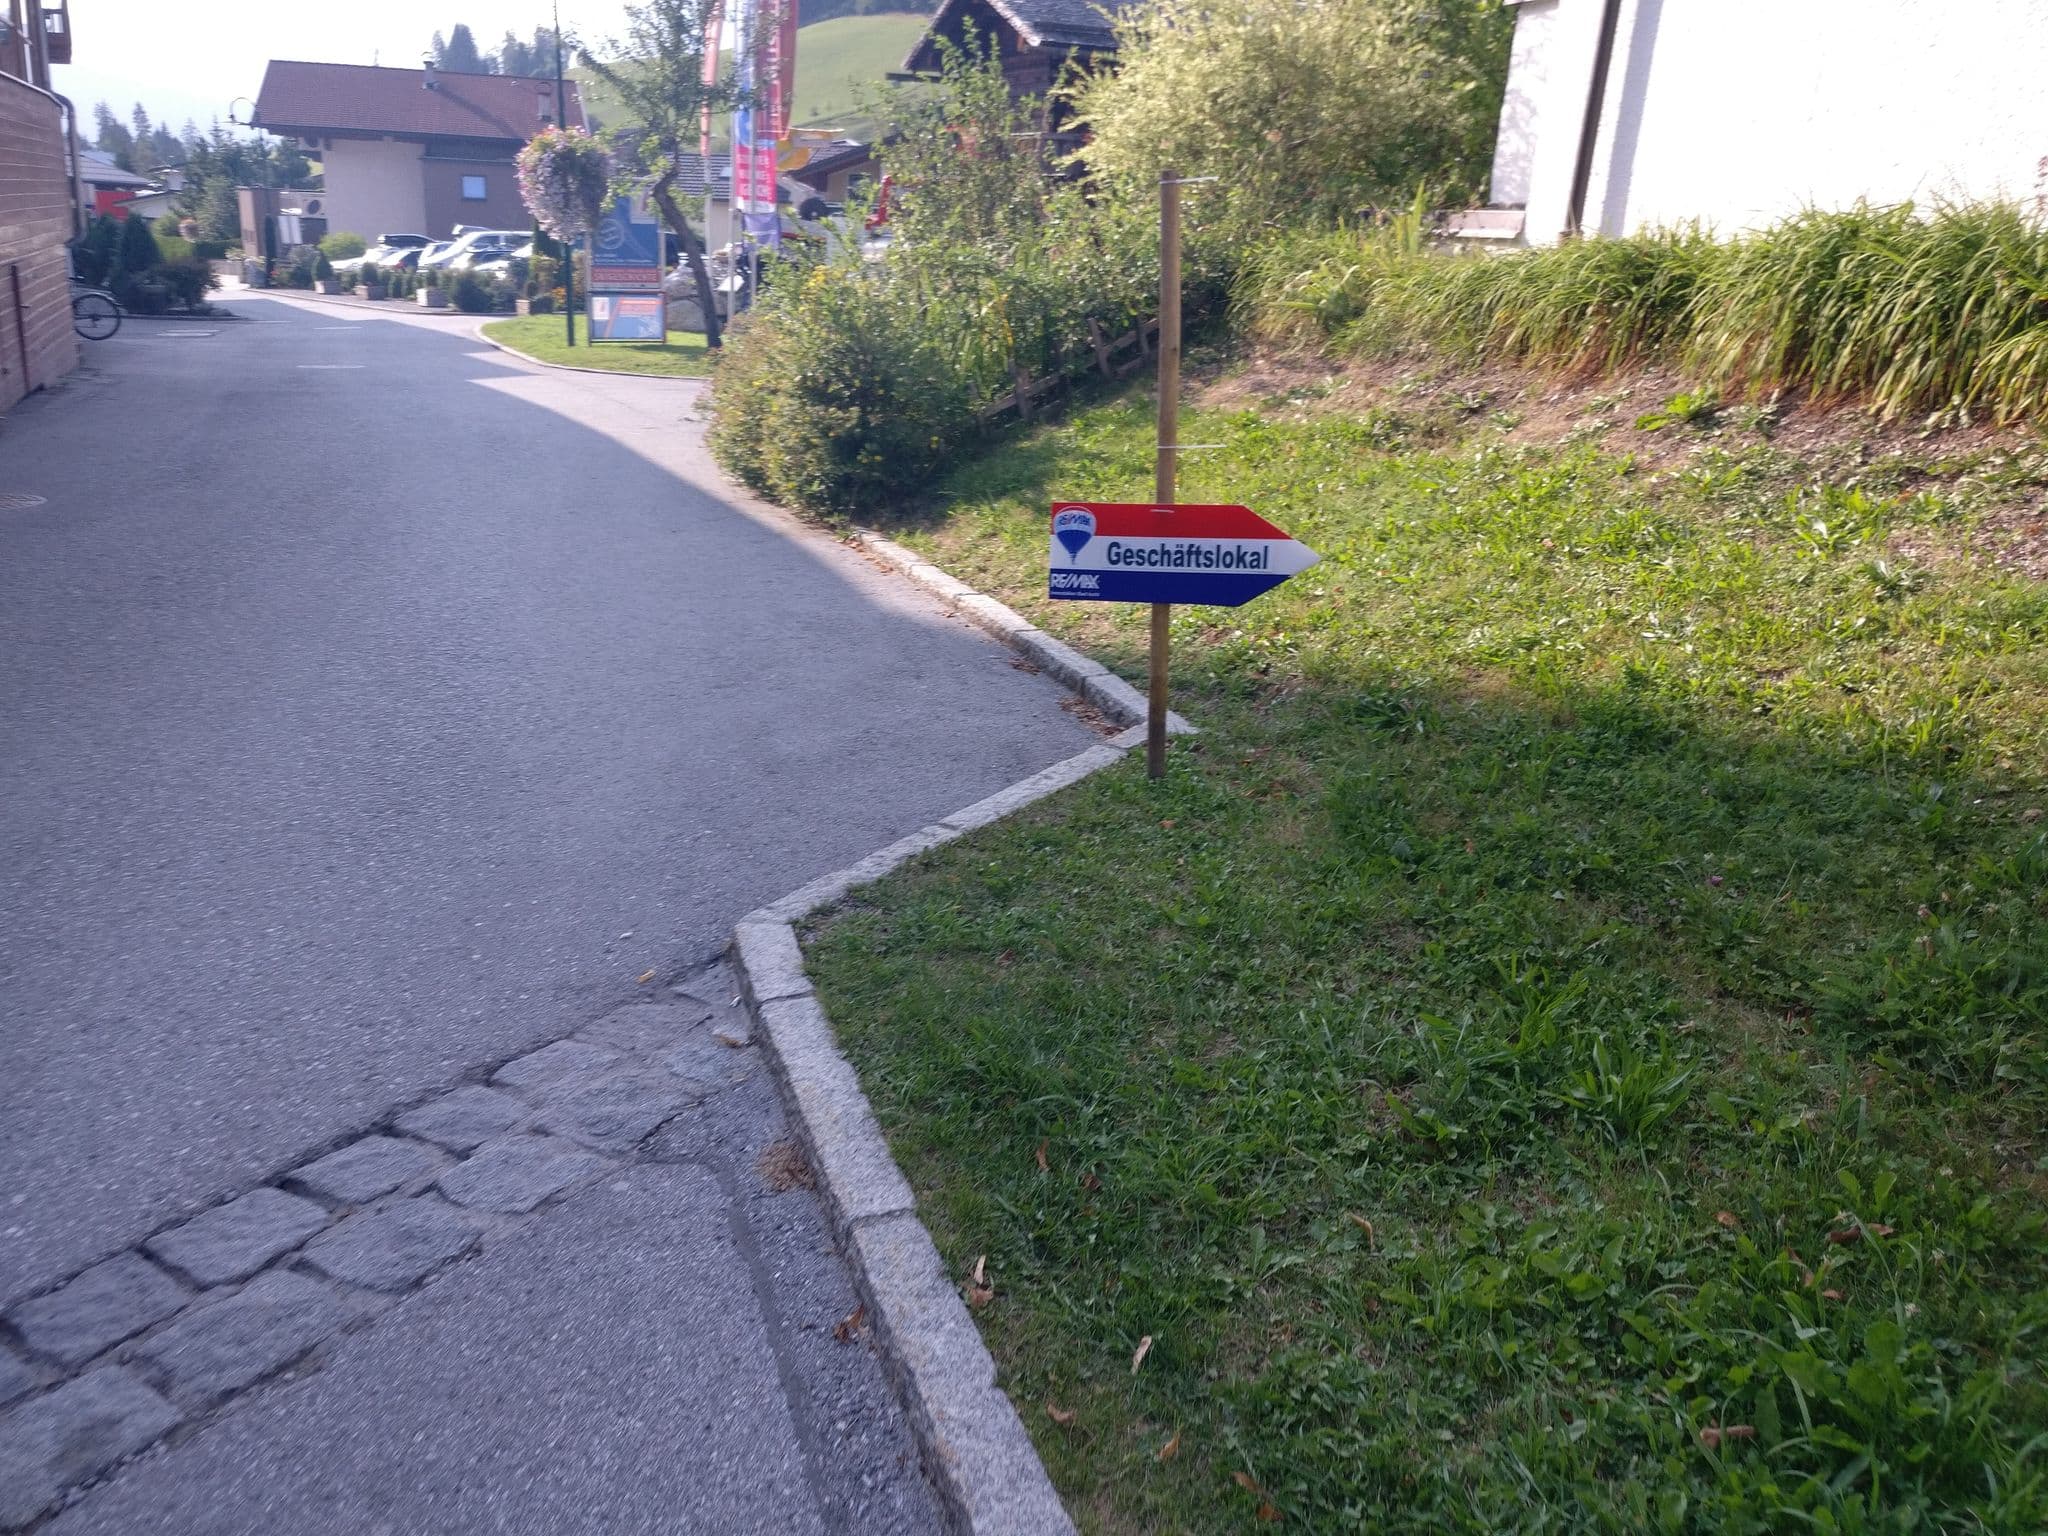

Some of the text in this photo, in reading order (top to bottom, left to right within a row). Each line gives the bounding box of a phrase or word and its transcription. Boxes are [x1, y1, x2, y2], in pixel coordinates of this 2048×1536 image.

[1058, 512, 1091, 527] RE/MAX
[1107, 541, 1268, 570] Geschäftslokal
[1050, 573, 1100, 589] RE/MAX
